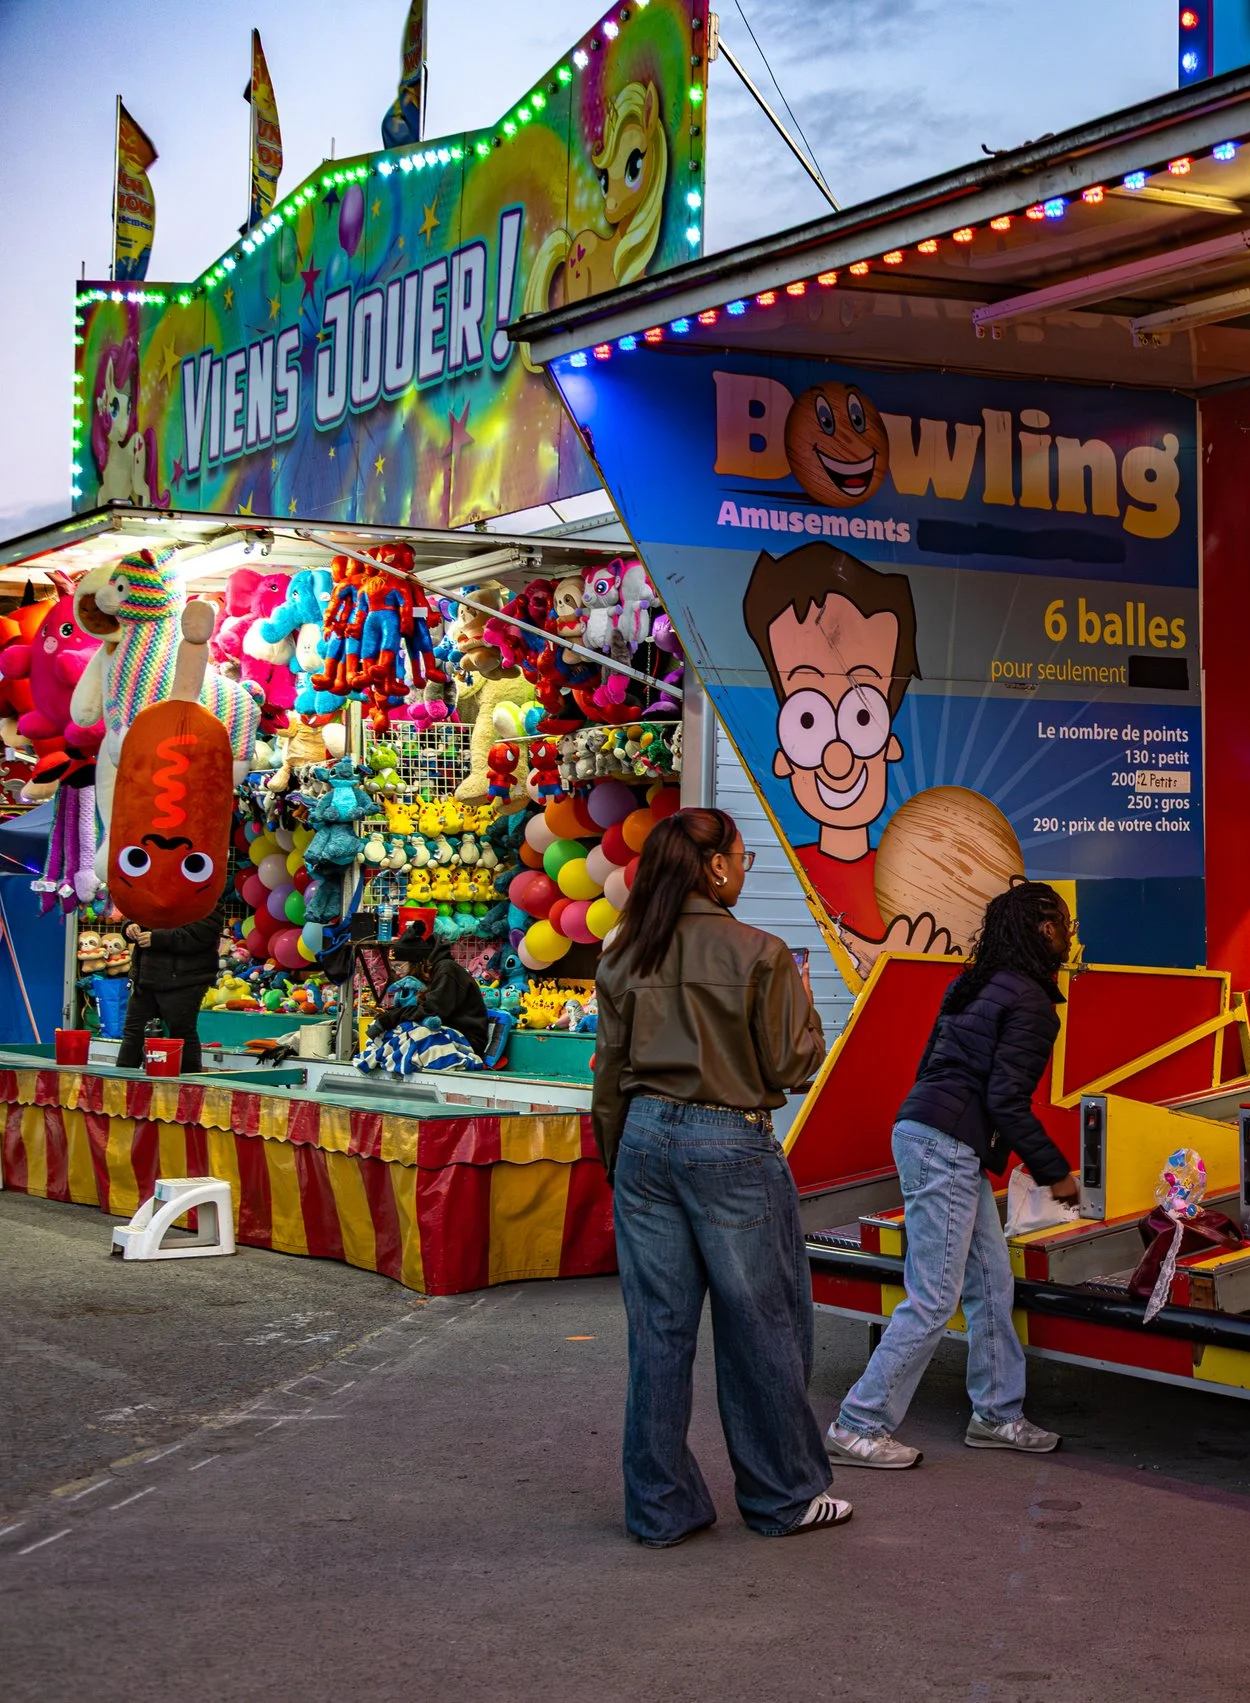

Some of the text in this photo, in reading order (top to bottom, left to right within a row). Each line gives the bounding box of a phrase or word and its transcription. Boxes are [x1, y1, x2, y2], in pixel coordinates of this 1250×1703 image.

[181, 207, 523, 474] VIENS JOUER!
[713, 370, 1181, 539] Bowling
[717, 500, 911, 543] Amusements
[1044, 598, 1186, 649] 6 balles
[991, 658, 1126, 684] pour seulement
[1038, 722, 1189, 745] Le nombre de points
[1125, 750, 1149, 764] 130
[1158, 750, 1190, 767] petit
[1111, 772, 1136, 786] 200
[1150, 774, 1178, 788] Petits
[1127, 795, 1152, 809] 250
[1161, 798, 1190, 813] gros
[1033, 818, 1059, 832] 290
[1068, 817, 1096, 836] prix
[1098, 817, 1115, 832] de
[1118, 819, 1153, 832] votre
[1155, 817, 1191, 832] choix
